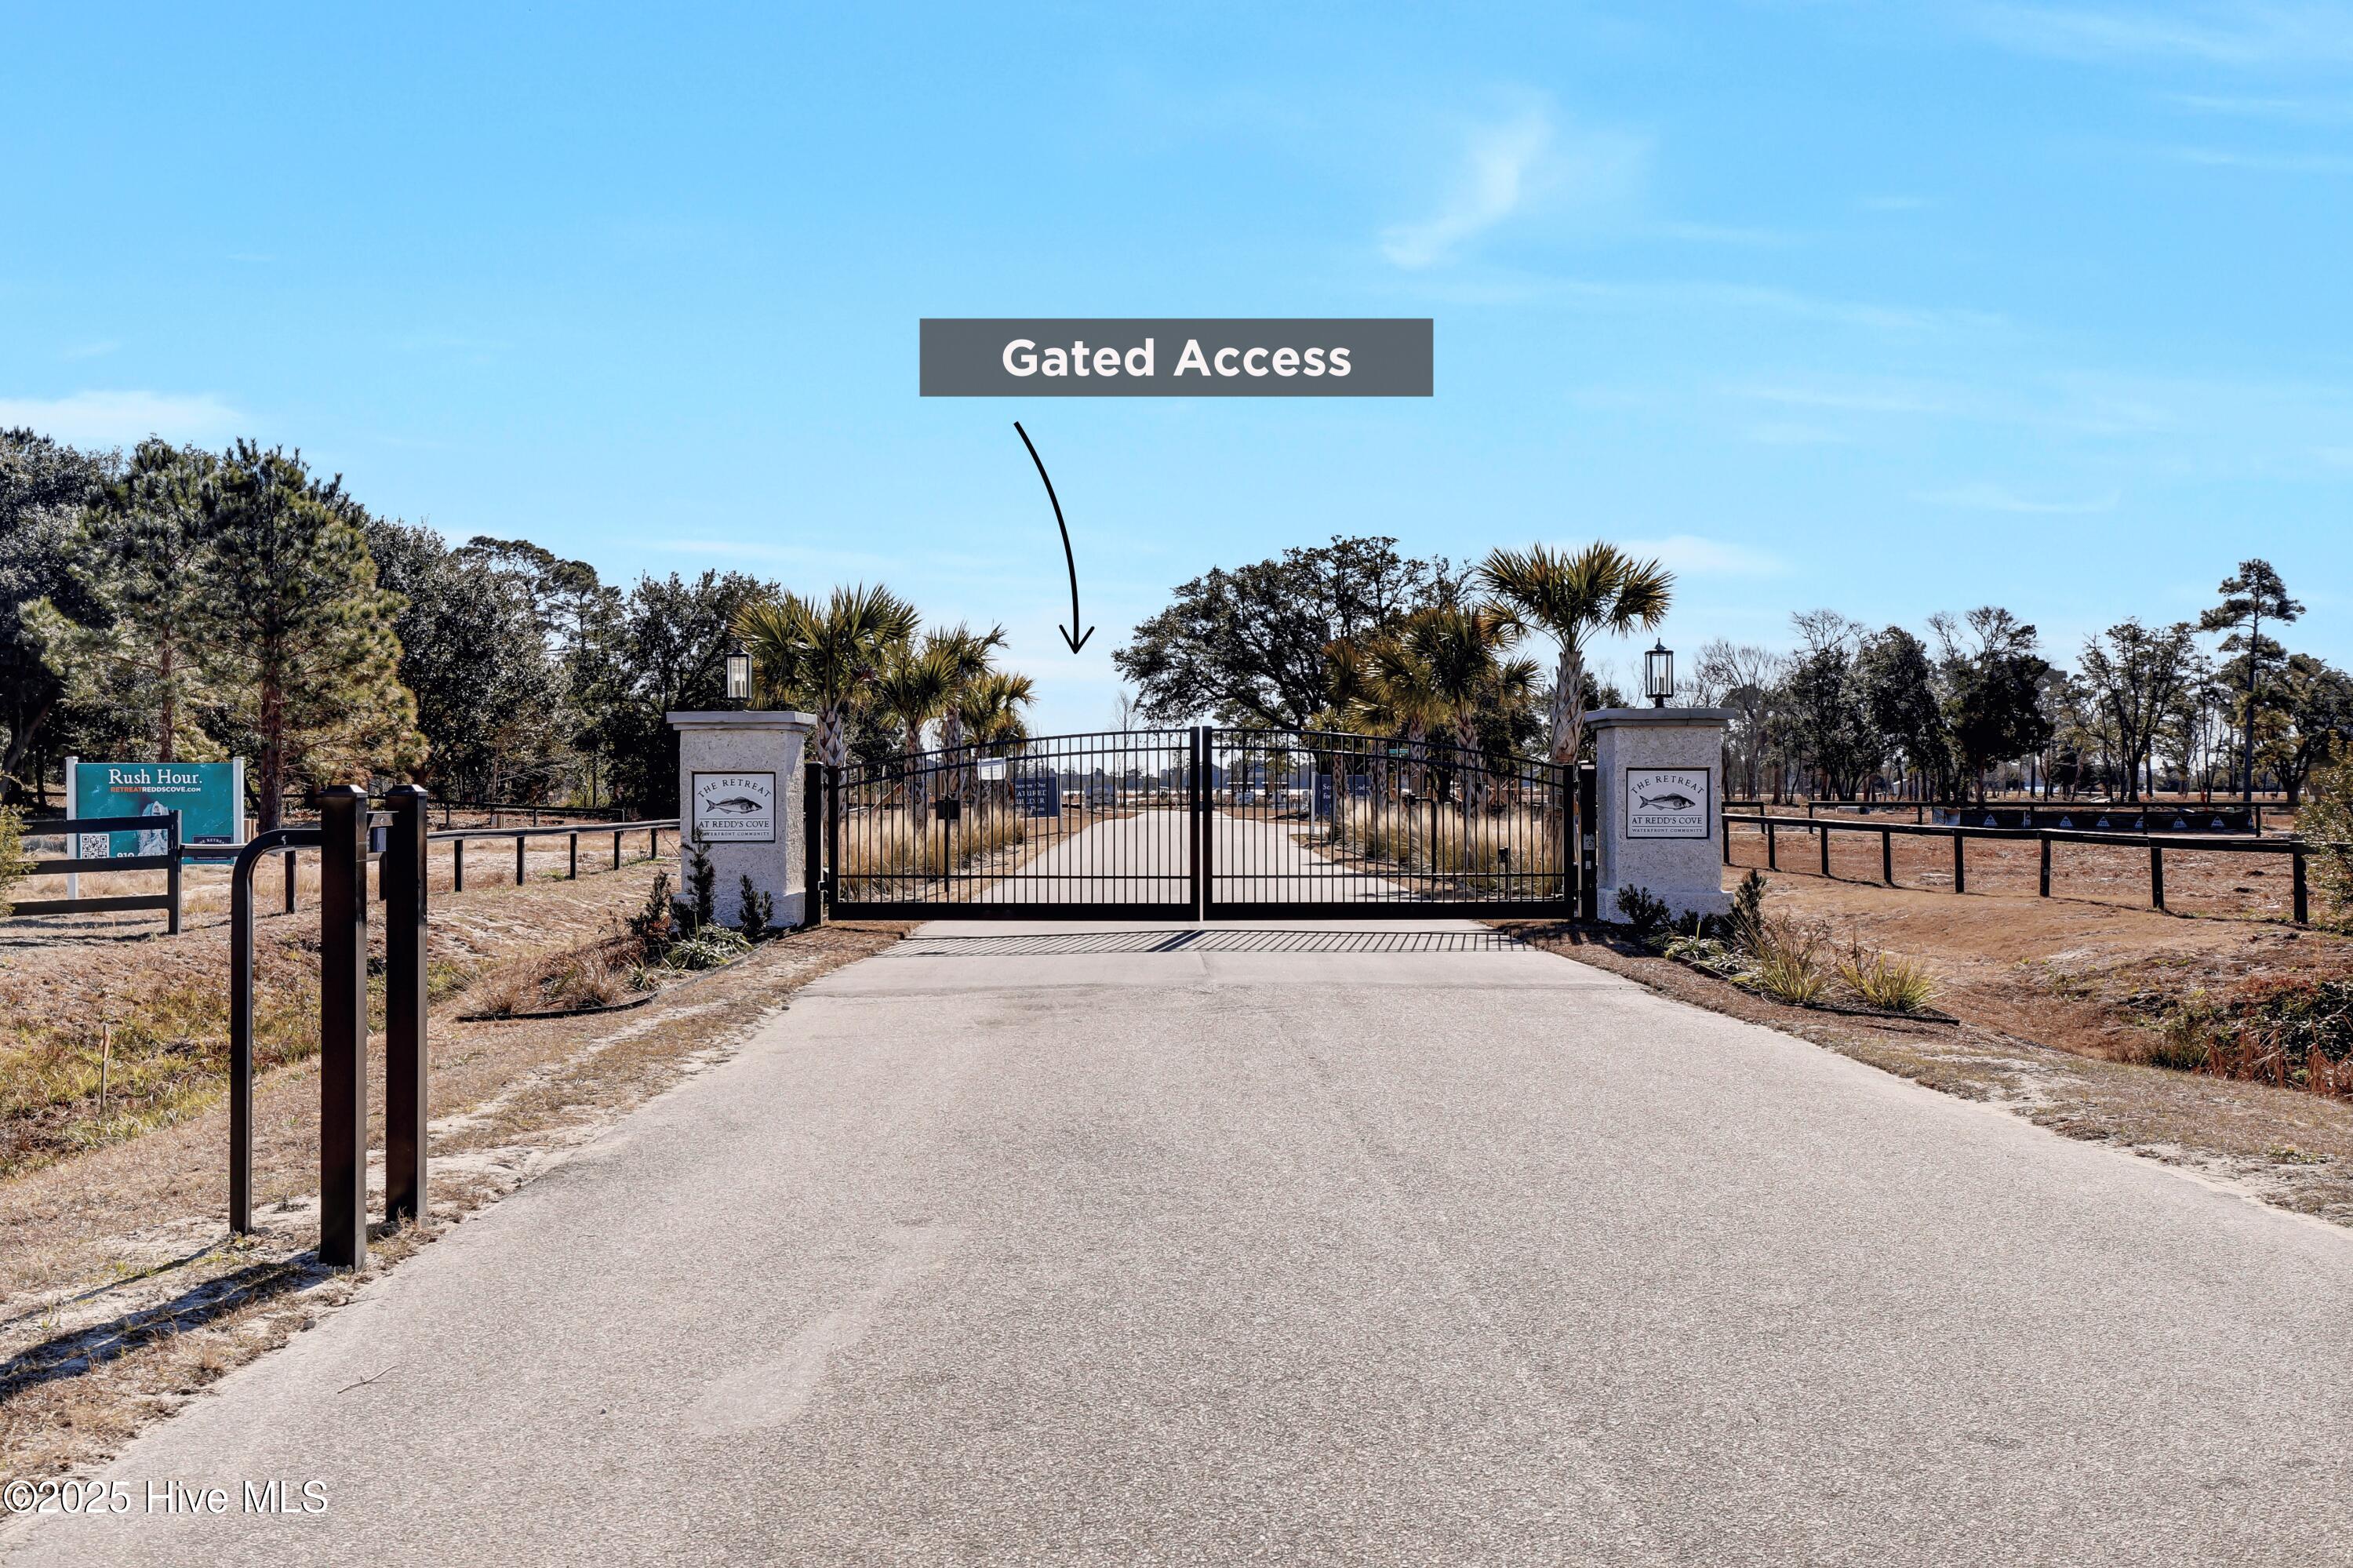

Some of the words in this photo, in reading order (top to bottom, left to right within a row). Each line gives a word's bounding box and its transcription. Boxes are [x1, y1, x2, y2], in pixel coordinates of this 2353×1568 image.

[108, 768, 151, 784] Rush
[157, 768, 203, 784] Hour.
[1631, 778, 1651, 795] THE
[1655, 775, 1704, 795] RETREAT
[697, 782, 718, 798] THE
[722, 778, 772, 798] RETREAT
